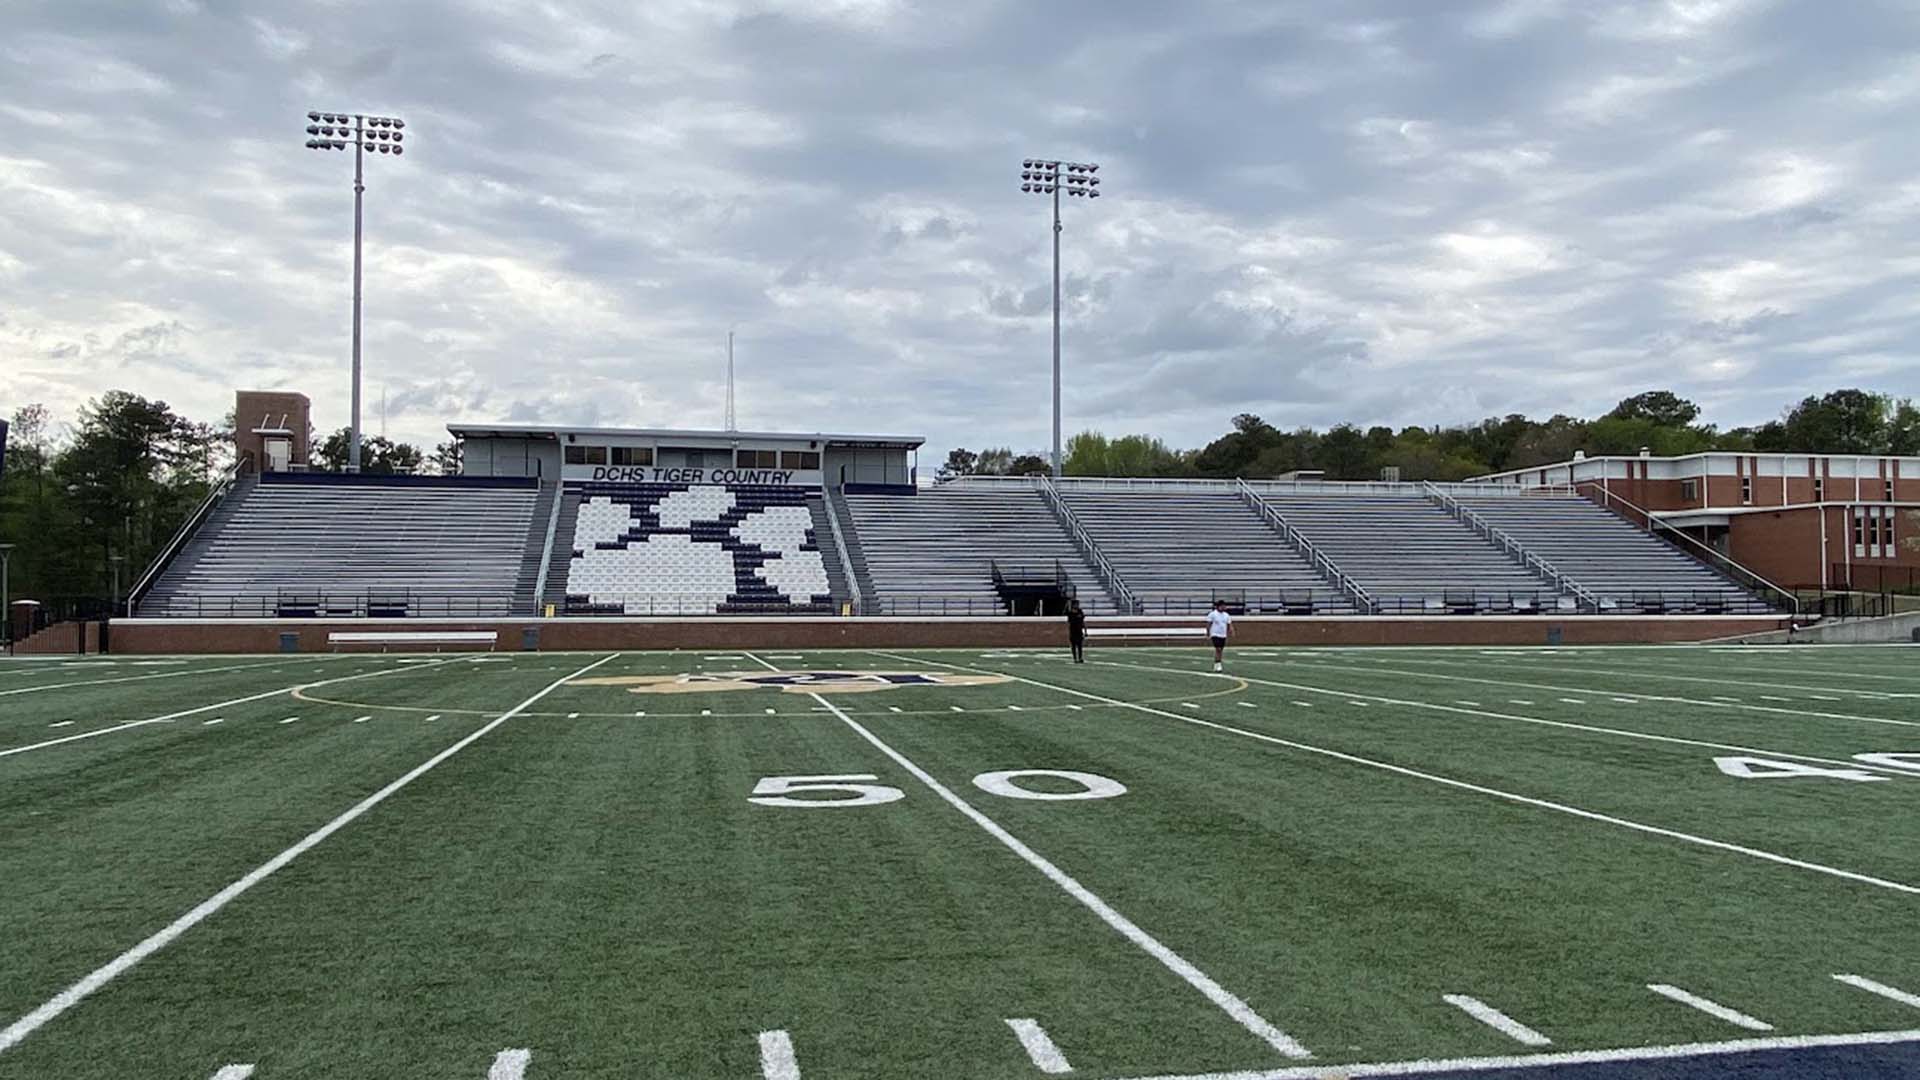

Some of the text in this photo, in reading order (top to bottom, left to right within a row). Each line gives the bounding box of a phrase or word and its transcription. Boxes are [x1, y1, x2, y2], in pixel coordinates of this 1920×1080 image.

[592, 467, 794, 484] DCHS TIGER COUNTRY
